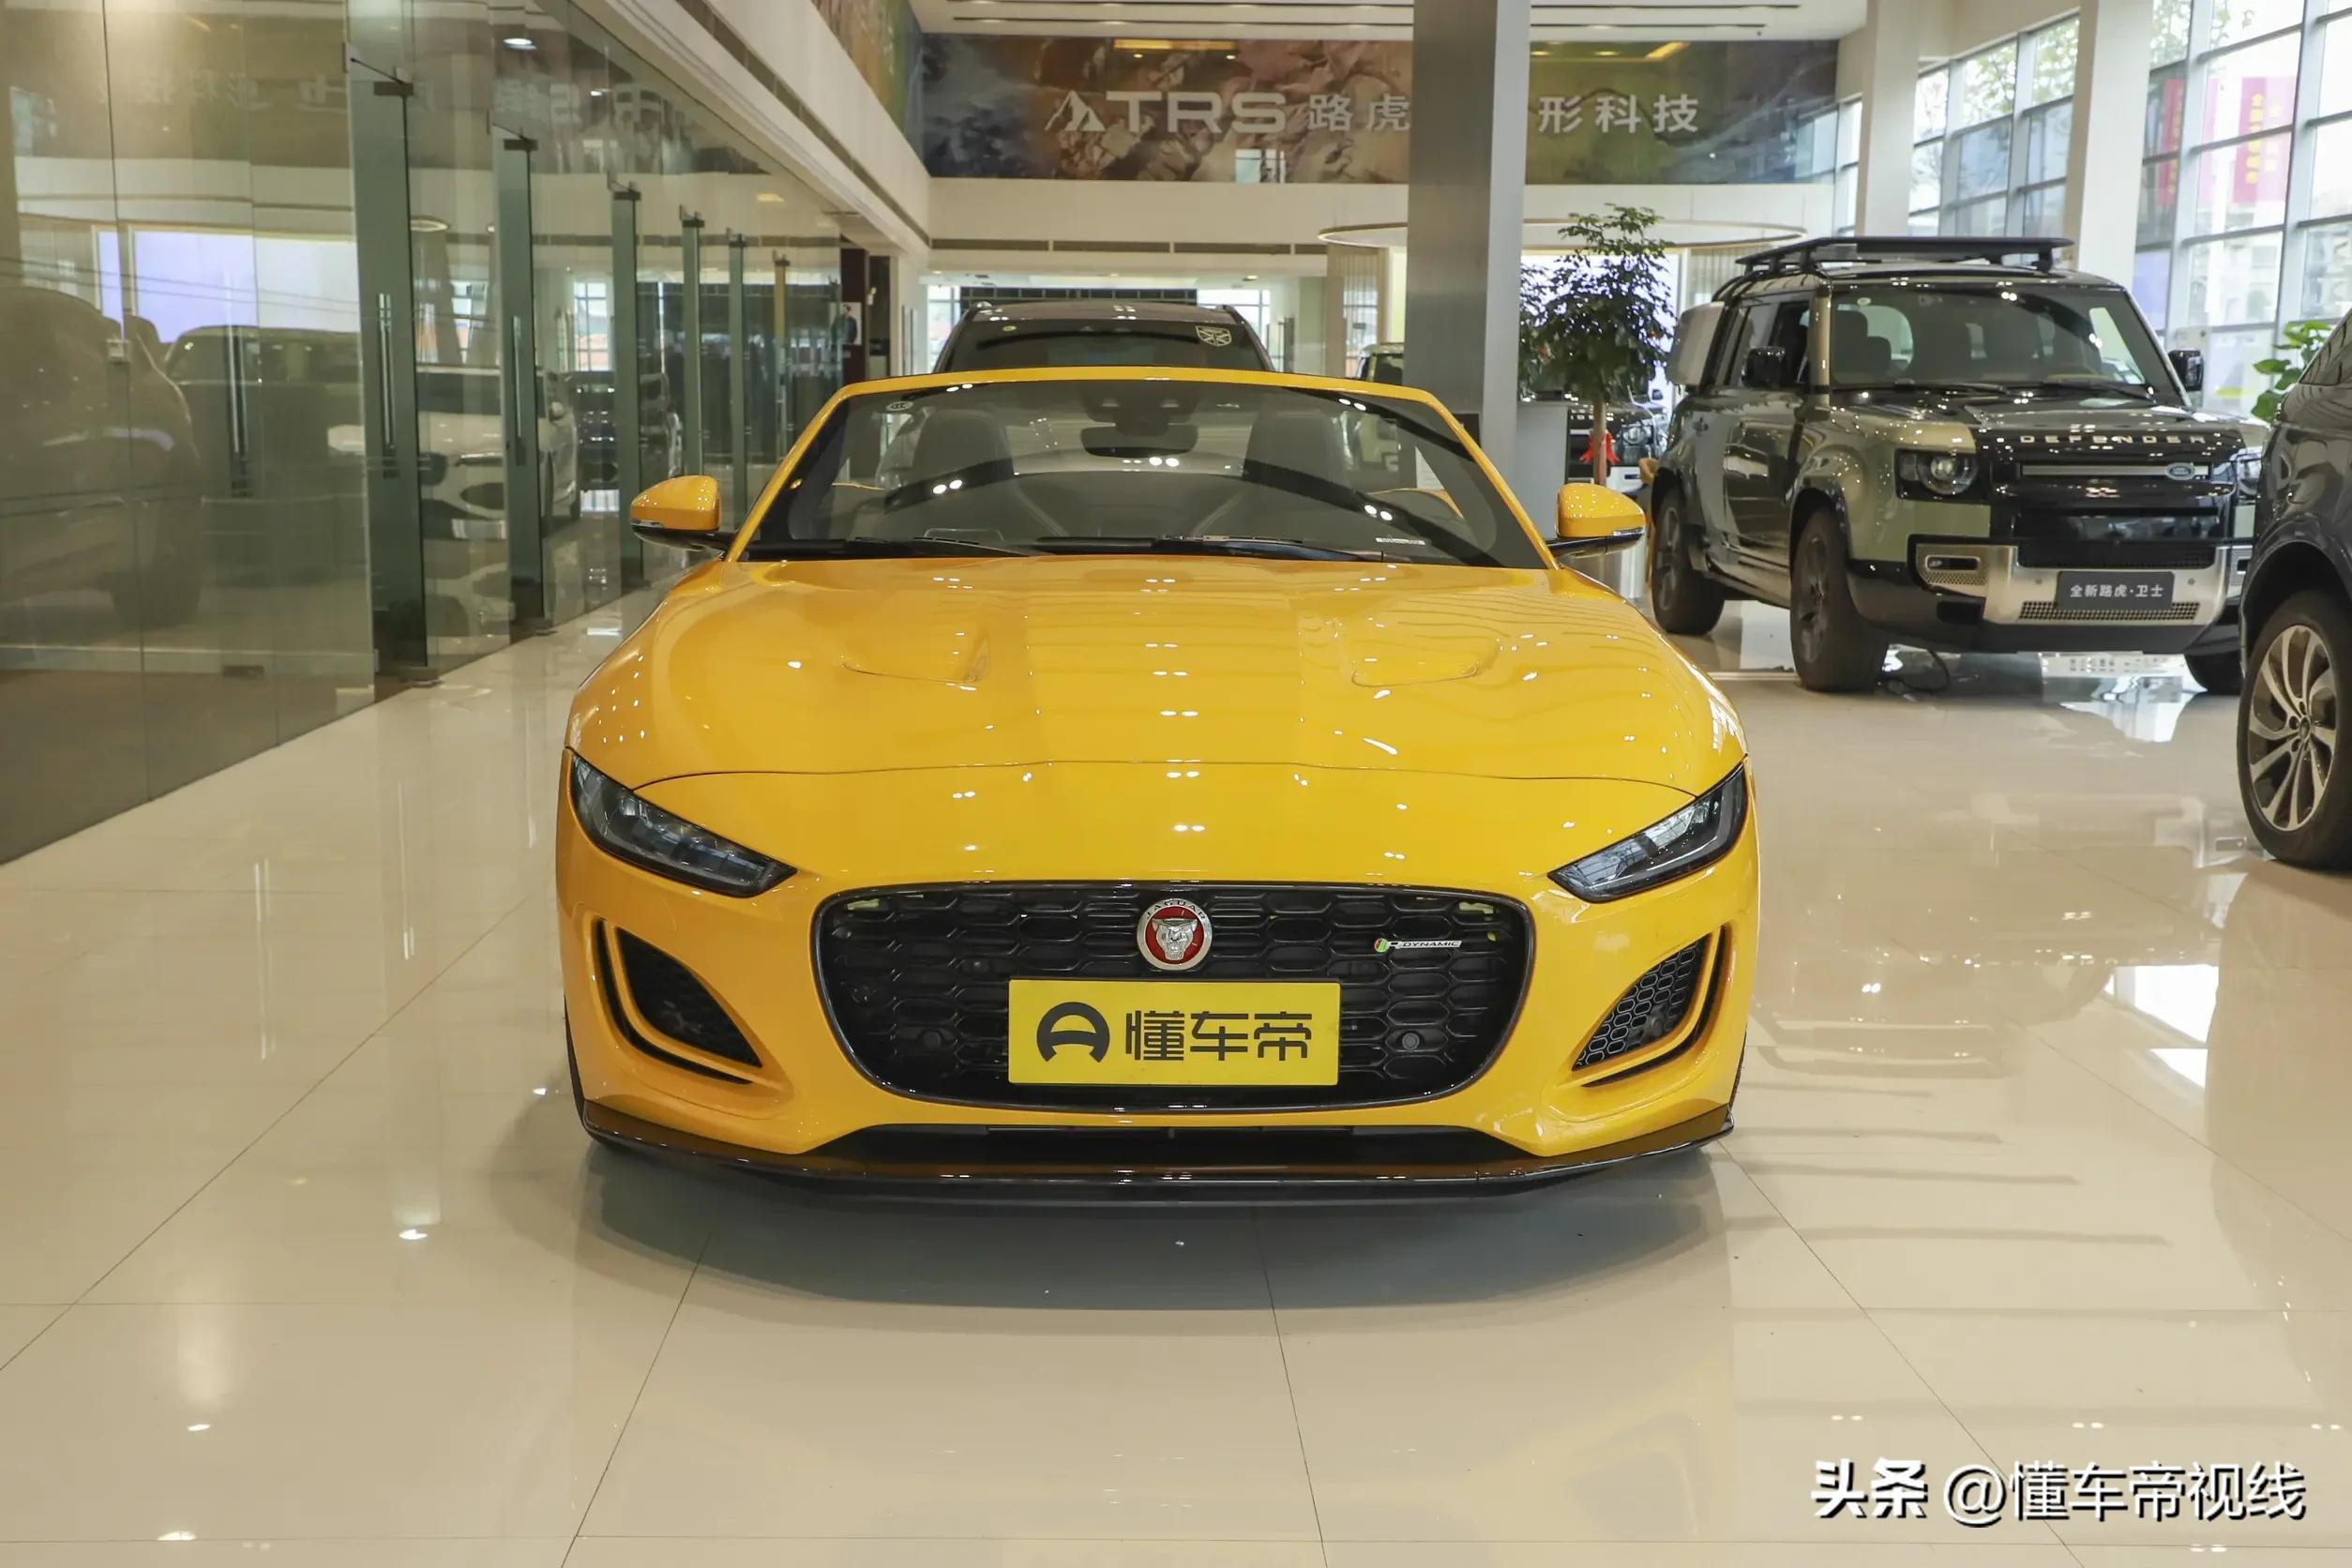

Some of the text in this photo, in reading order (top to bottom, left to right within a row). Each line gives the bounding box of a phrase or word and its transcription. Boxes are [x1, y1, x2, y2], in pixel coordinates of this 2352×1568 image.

[1309, 95, 1410, 132] 路虎
[1538, 93, 1699, 133] 形科技
[2020, 435, 2206, 444] DEFENDER
[1146, 899, 1206, 920] JAGUAR
[1125, 1010, 1312, 1062] 懂车帝
